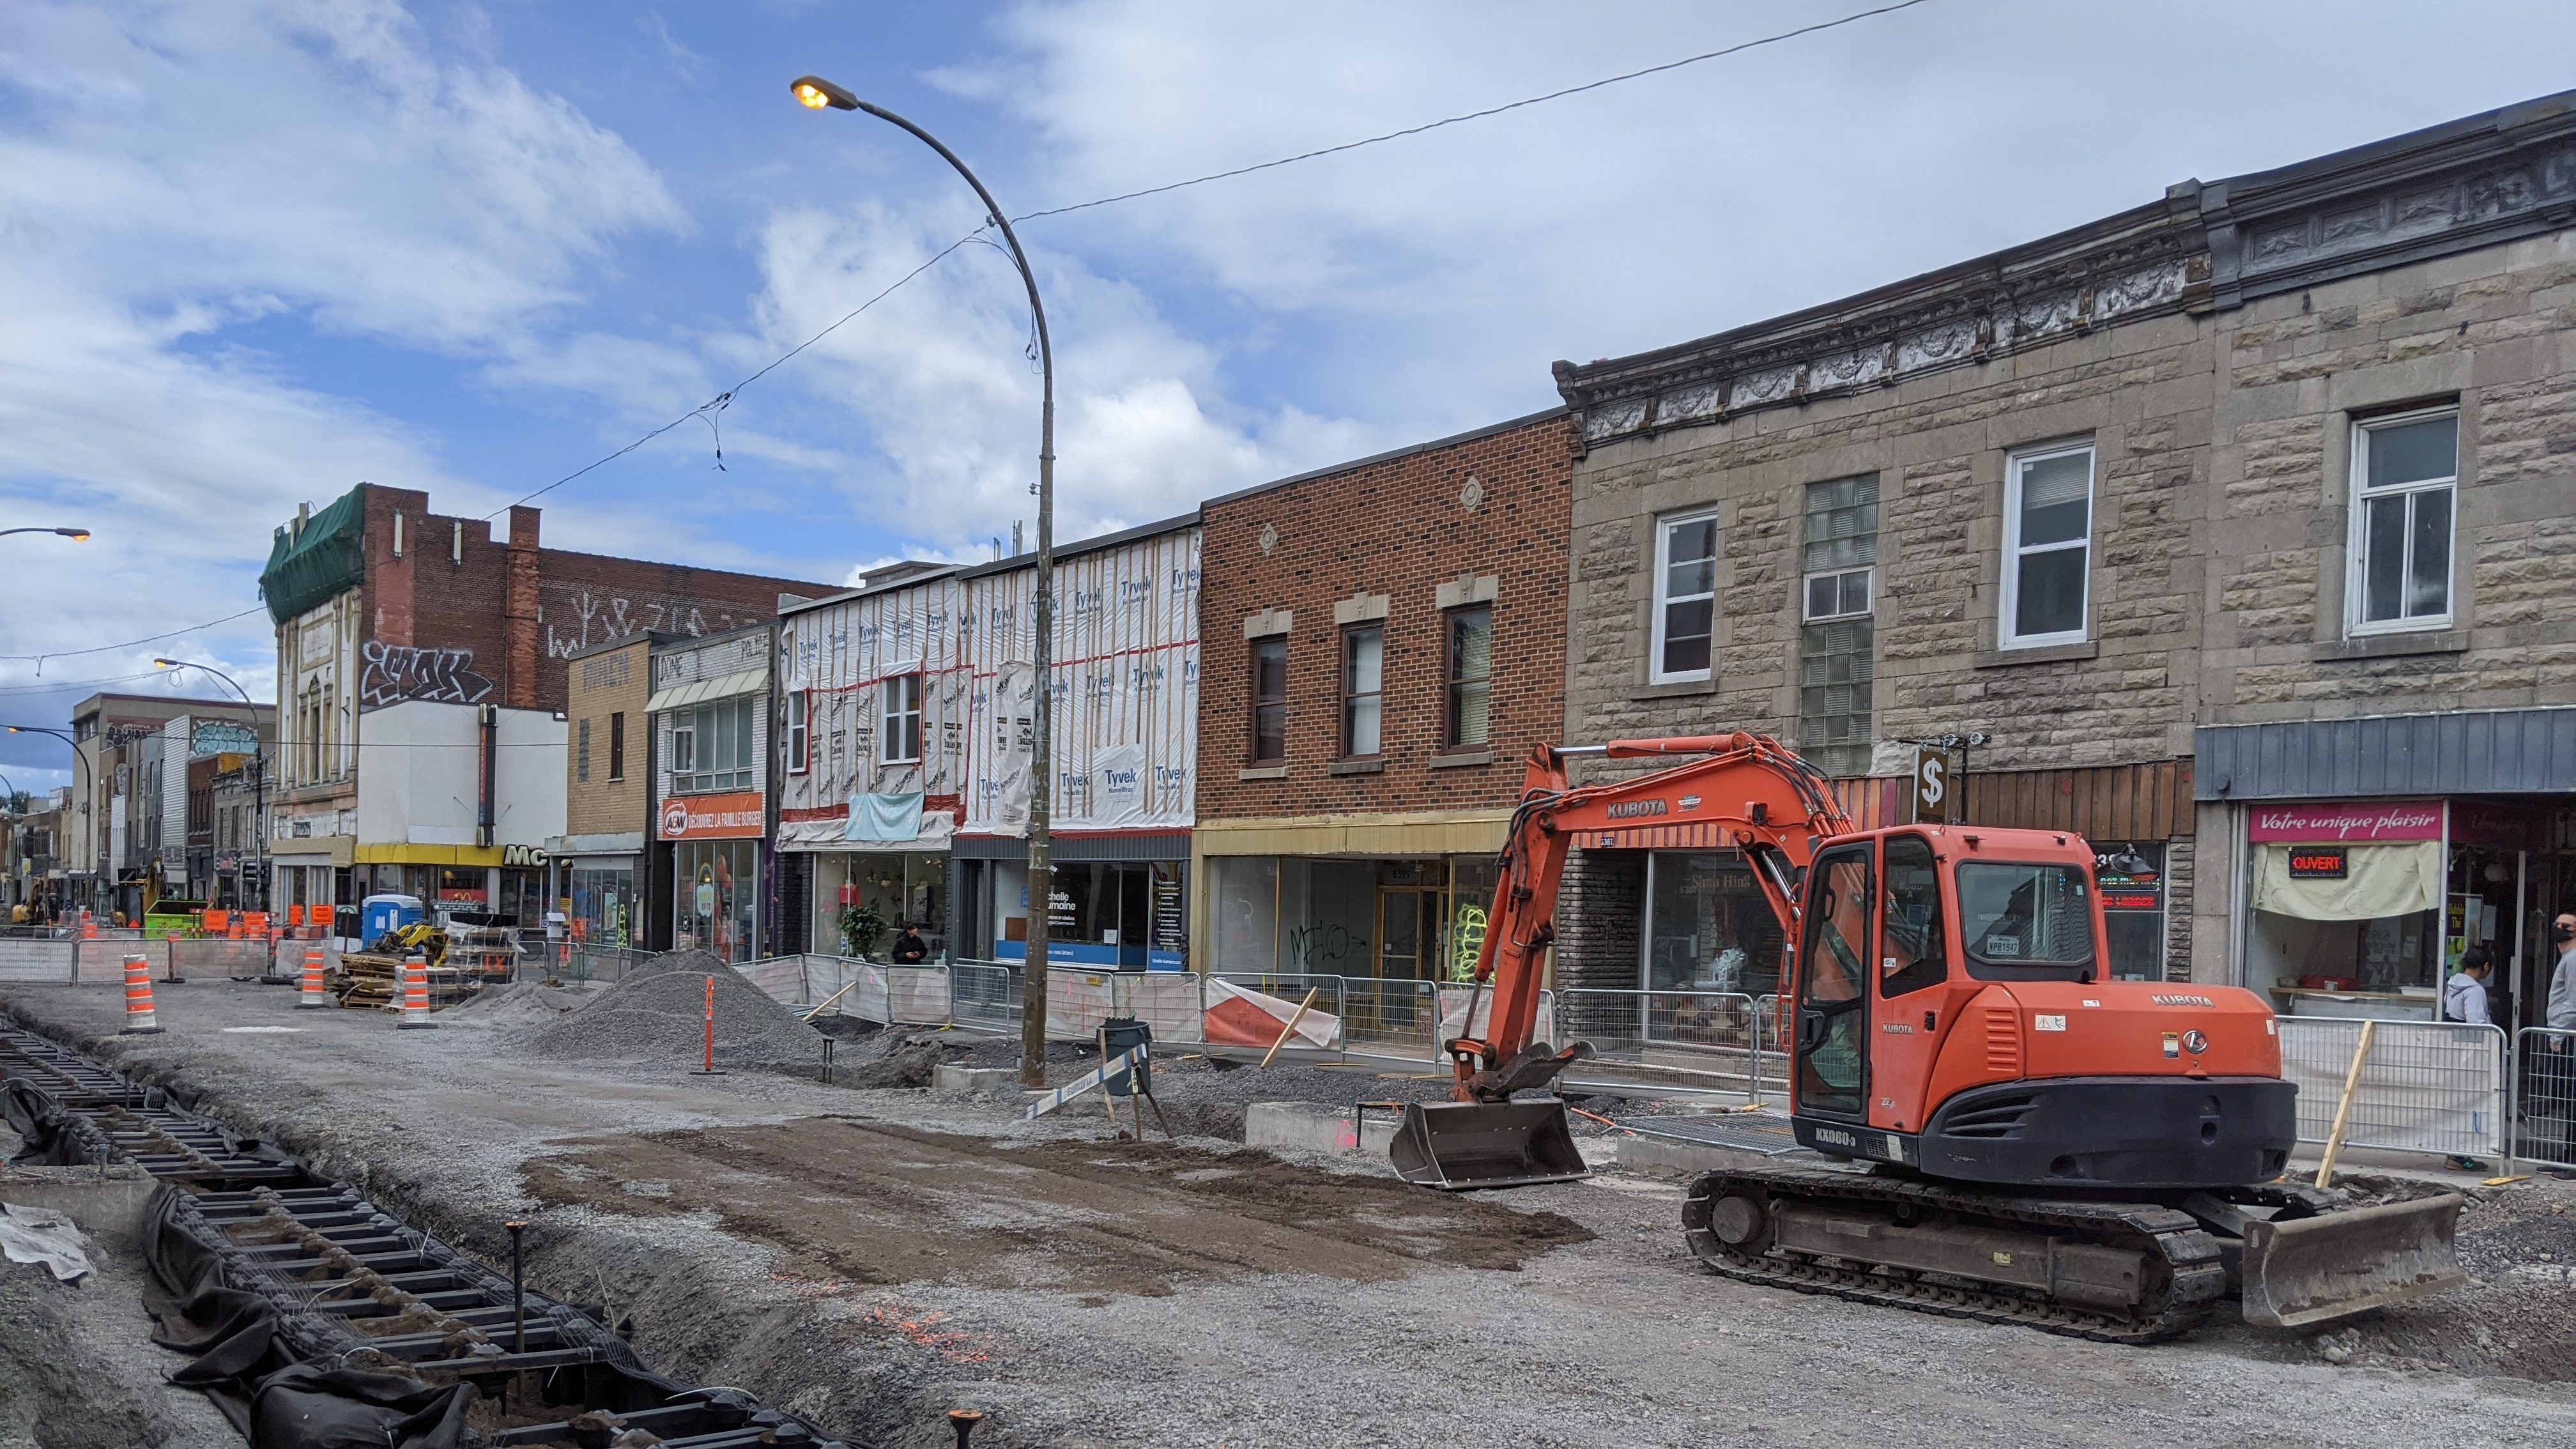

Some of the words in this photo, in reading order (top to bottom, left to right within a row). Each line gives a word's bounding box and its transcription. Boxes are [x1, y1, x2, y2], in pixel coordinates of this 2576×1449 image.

[1105, 768, 1137, 788] Tyvek
[1108, 785, 1133, 794] HomeWrap
[1607, 799, 1668, 820] KUBOTA
[666, 815, 686, 830] A&W
[688, 812, 714, 829] DÉCOUVREZ
[715, 813, 722, 827] LA
[722, 811, 741, 827] FAMILLE
[741, 810, 762, 827] BURGER
[2261, 811, 2307, 830] Votre
[2310, 815, 2373, 839] unique
[2371, 808, 2435, 838] plaisir
[2294, 856, 2340, 870] OUVERT
[2150, 994, 2216, 1008] KUBOTA
[1883, 1023, 1913, 1035] KUBOTA
[1067, 1076, 1092, 1097] EUROVIA
[1816, 1127, 1857, 1147] KX080-3
